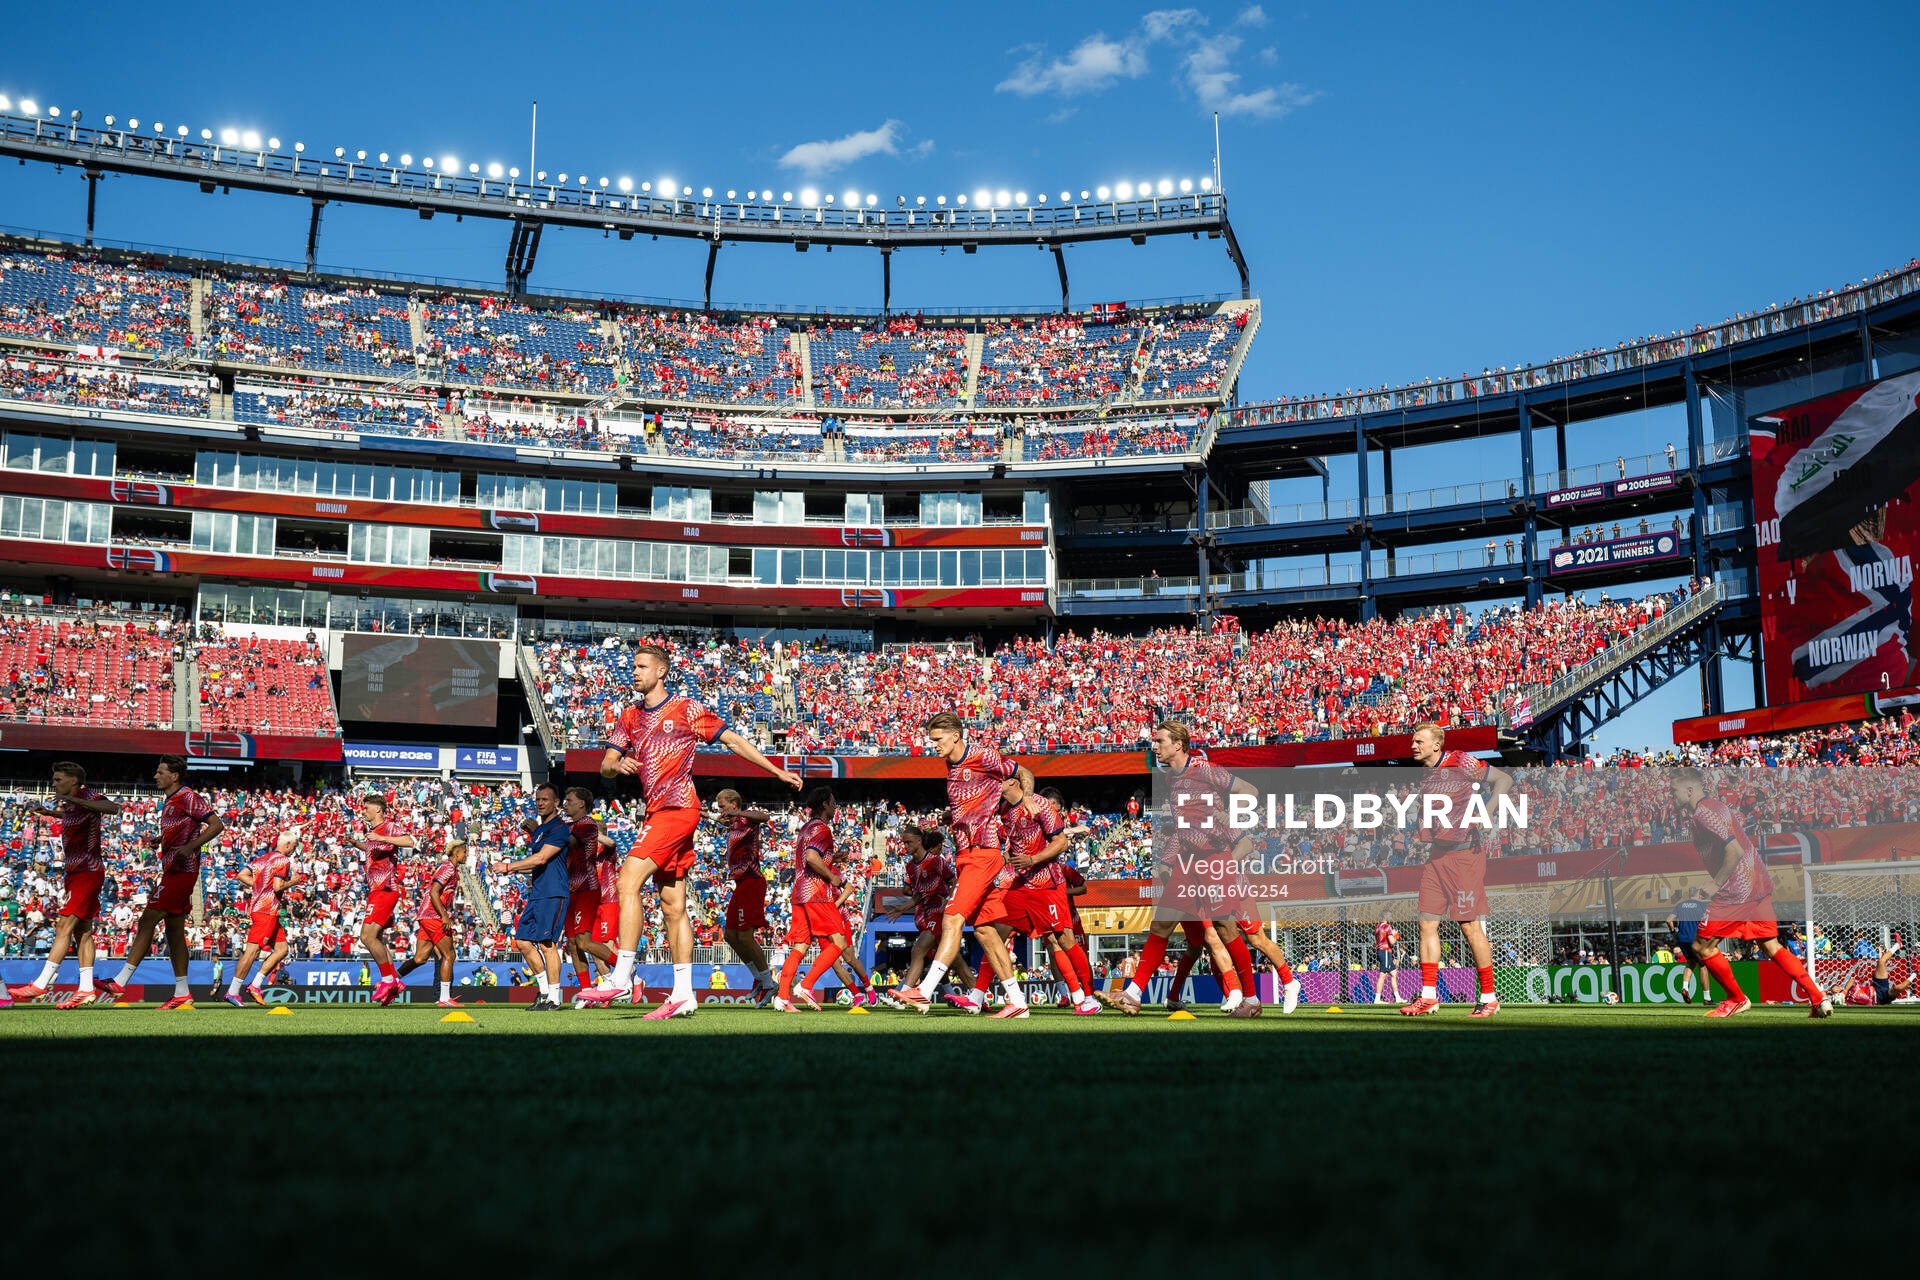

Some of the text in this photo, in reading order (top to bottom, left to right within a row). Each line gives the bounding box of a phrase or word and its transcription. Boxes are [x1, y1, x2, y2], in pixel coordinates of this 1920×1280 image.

[1628, 479, 1649, 491] 2008
[1560, 490, 1580, 502] 2007
[315, 502, 347, 514] NORWAY
[683, 526, 699, 537] IRAQ
[1576, 546, 1609, 565] 2021
[1612, 545, 1655, 559] WINNERS
[312, 567, 344, 578] NORWAY
[682, 588, 699, 598] IRAQ
[1808, 630, 1879, 667] NORWAY
[452, 678, 480, 687] NORWAY
[1718, 718, 1746, 732] NORWAY
[344, 749, 433, 760] WORLD CUP 2026
[476, 751, 497, 760] FIFA
[1356, 743, 1375, 755] IRAQ
[1537, 861, 1557, 877] IRAQ
[1457, 890, 1475, 908] 24
[1048, 904, 1059, 920] 9
[307, 971, 351, 986] FIFA
[1526, 965, 1697, 1003] aramco
[305, 990, 411, 1003] HYUNI
[1147, 976, 1197, 1005] VIA
